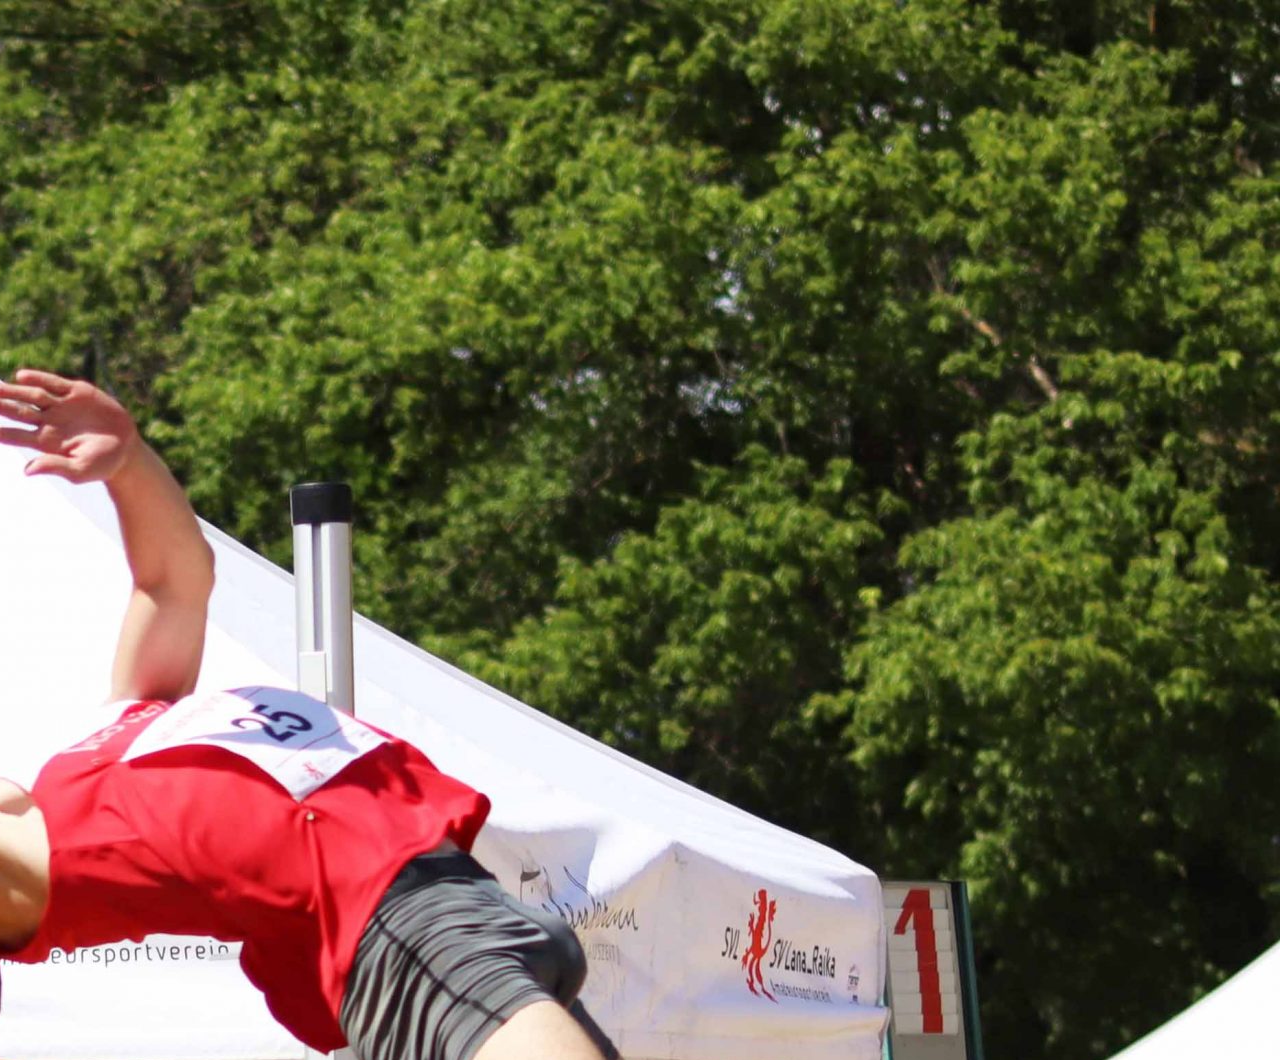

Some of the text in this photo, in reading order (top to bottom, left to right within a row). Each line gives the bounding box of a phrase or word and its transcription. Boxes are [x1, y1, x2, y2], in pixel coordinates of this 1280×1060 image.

[231, 704, 313, 743] 25
[50, 939, 230, 967] eursportverein
[721, 926, 741, 960] SVL
[894, 888, 944, 1033] 1
